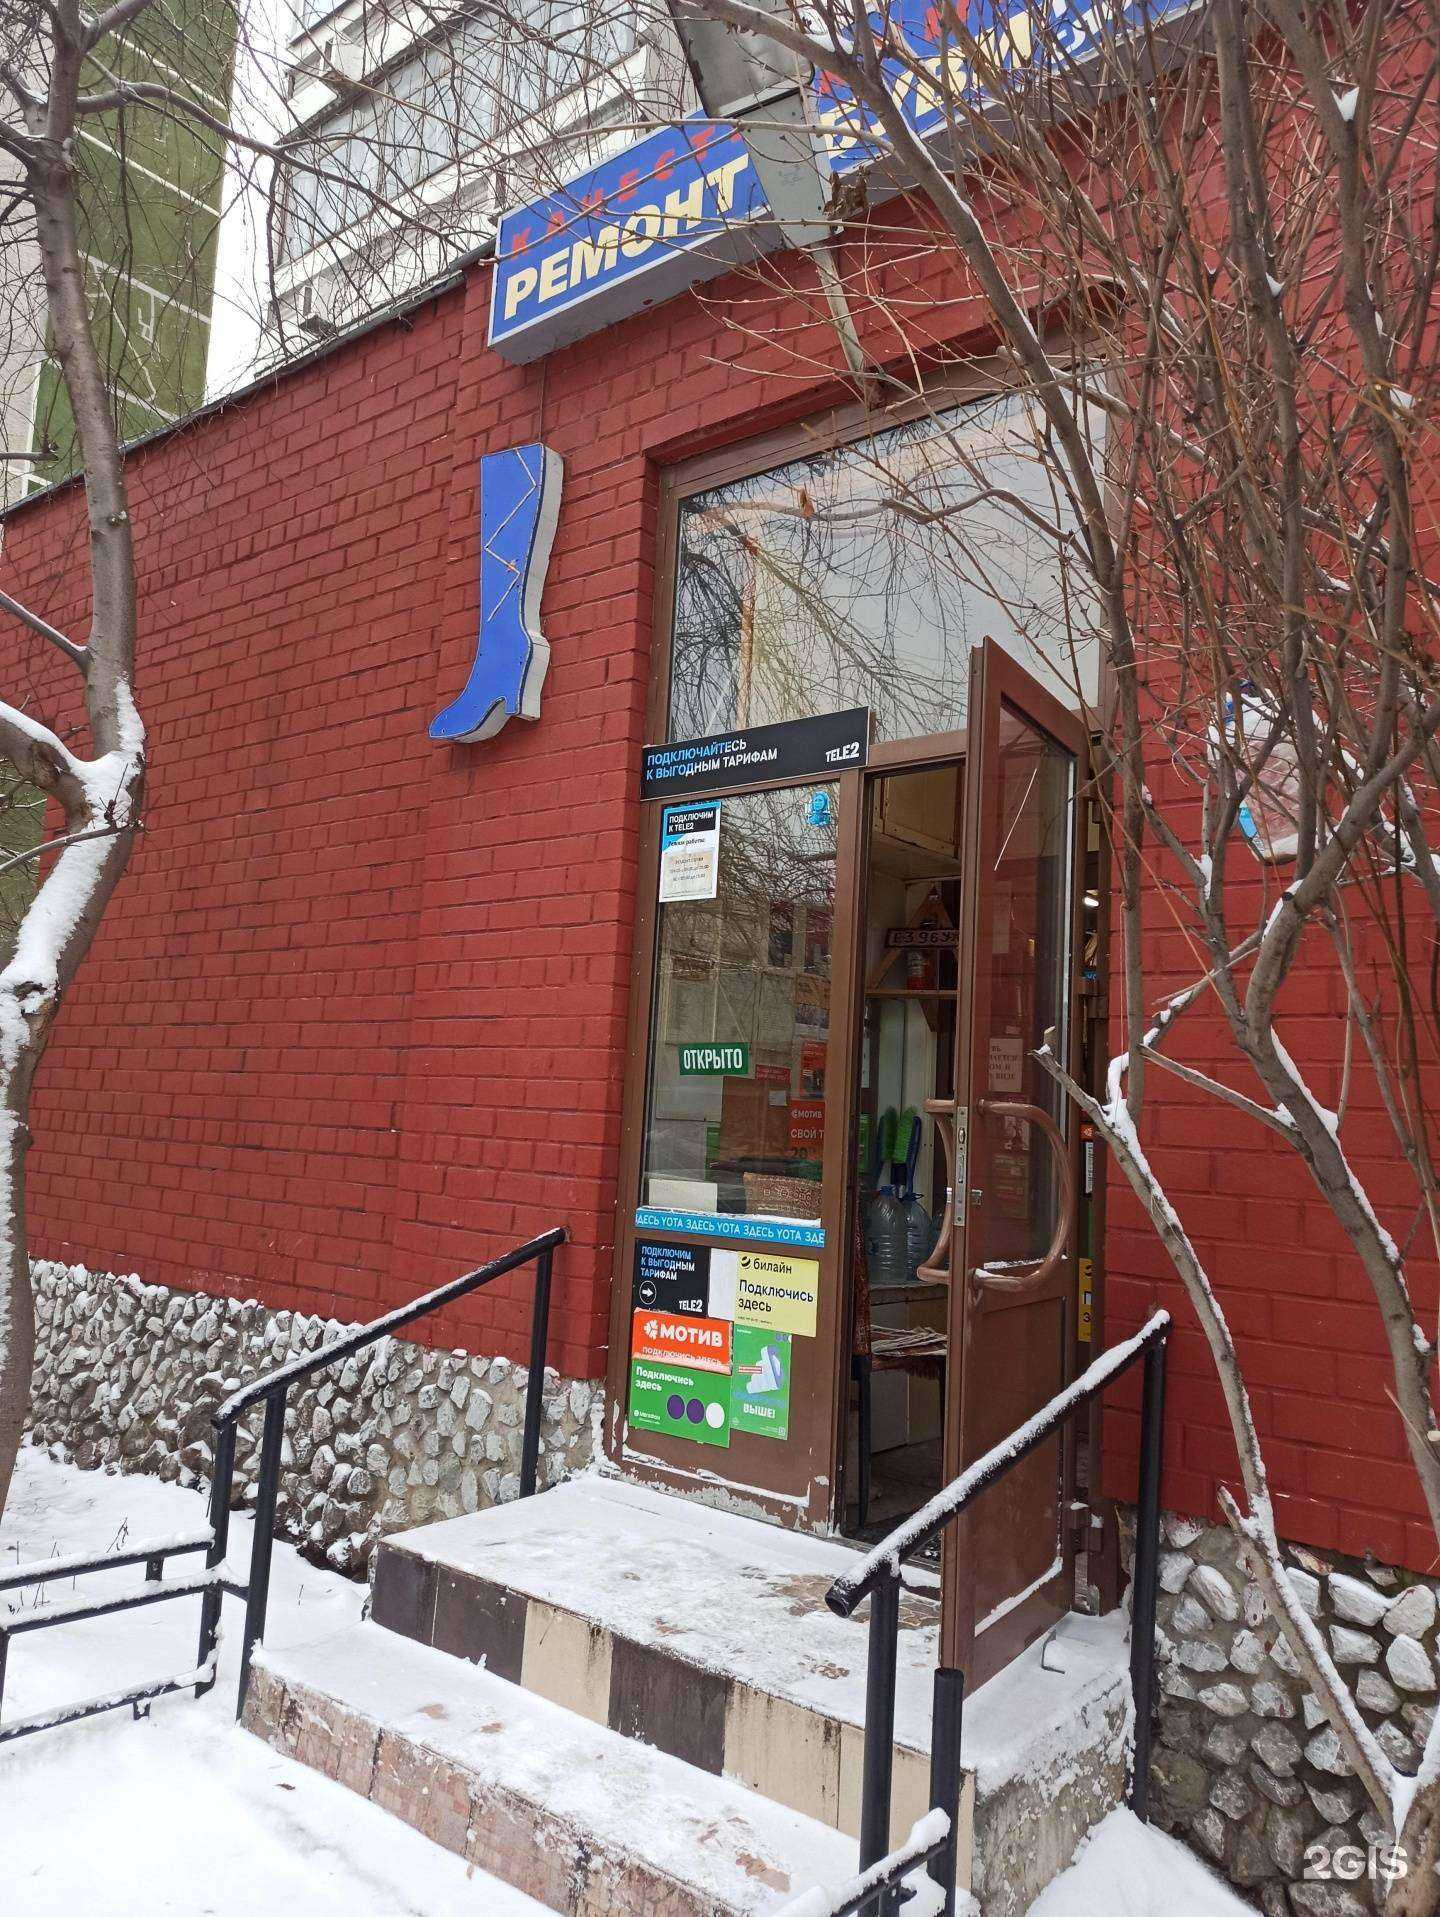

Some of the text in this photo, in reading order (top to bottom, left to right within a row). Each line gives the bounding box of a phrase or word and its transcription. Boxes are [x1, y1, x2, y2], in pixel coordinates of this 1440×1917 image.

[504, 153, 749, 320] РЕМОНТ
[647, 739, 747, 766] ПОДКЛЮЧАЙТЕСЬ
[825, 741, 860, 763] TELE2
[646, 748, 778, 781] К ВЫГОДНЫМ ТАРИФАМ
[669, 810, 714, 824] ПОДКЛЮЧИМ
[675, 824, 694, 832] TELE2
[684, 1048, 743, 1070] ОТКРЫТО
[799, 1110, 822, 1119] МОТИВ
[791, 1126, 817, 1139] СВОЙ
[636, 1213, 660, 1226] ДЕСЬ
[661, 1216, 684, 1228] YOTA
[686, 1219, 715, 1232] ЗДЕСЬ
[717, 1223, 741, 1235] YOTA
[743, 1225, 774, 1237] ЗДЕСЬ
[777, 1228, 801, 1241] YOTA
[641, 1246, 691, 1260] ПОДКЛЮЧИМ
[641, 1257, 695, 1272] К ВЫГОДНЫМ
[753, 1258, 792, 1275] билайн
[641, 1267, 677, 1281] ТАРИФАМ
[739, 1279, 814, 1303] Подключись
[679, 1299, 703, 1313] TELE2
[738, 1297, 772, 1313] здесь
[660, 1323, 723, 1348] МОТИВ
[636, 1365, 694, 1386] Подключись
[635, 1380, 662, 1391] здесь
